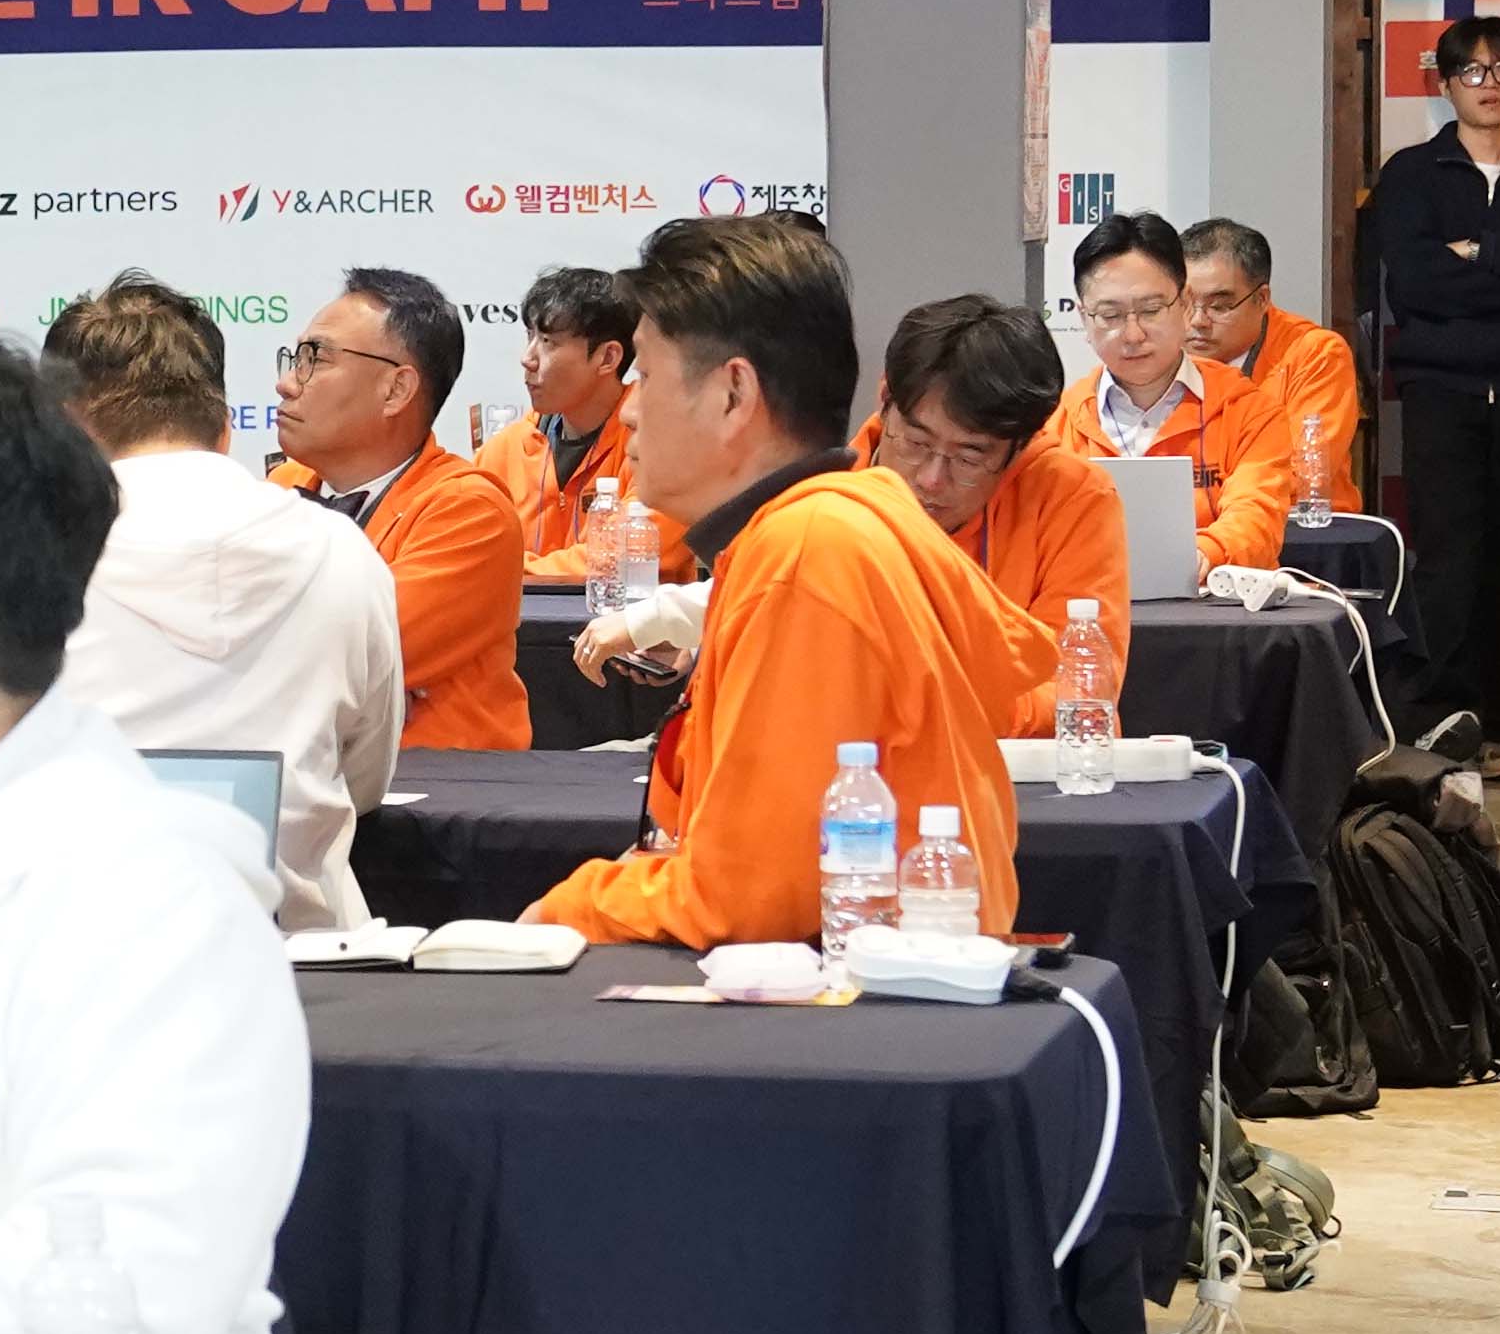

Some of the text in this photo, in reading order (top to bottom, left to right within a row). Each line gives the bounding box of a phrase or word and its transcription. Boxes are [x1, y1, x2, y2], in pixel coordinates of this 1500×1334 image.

[33, 185, 178, 220] partners
[272, 187, 434, 215] Y&ARCHER
[515, 182, 657, 215] 웰컴벤처스
